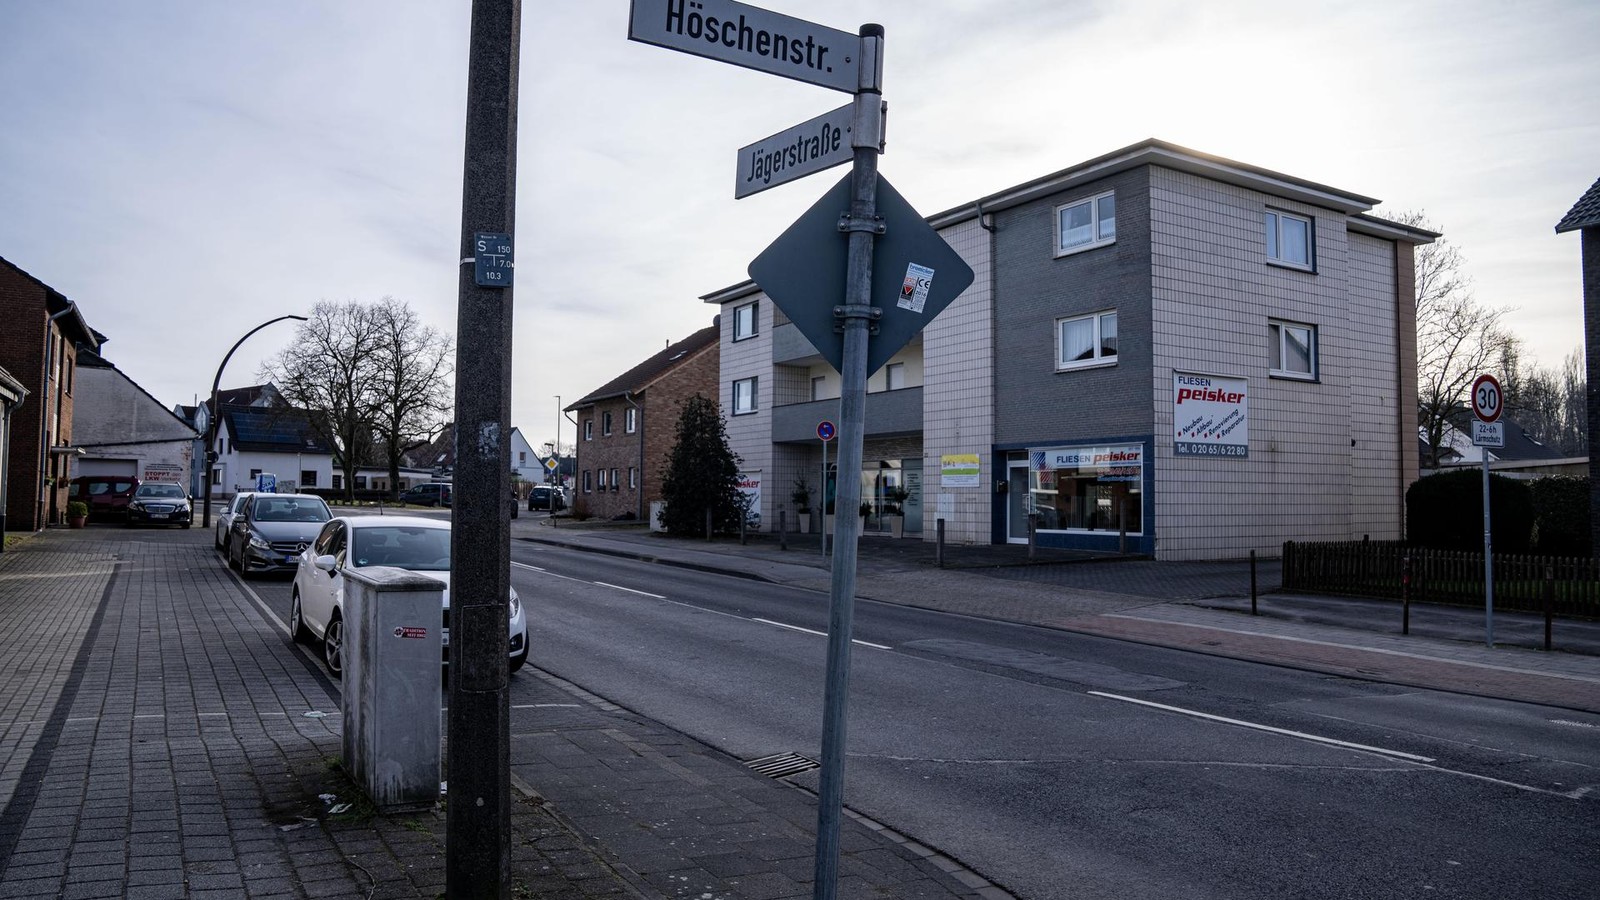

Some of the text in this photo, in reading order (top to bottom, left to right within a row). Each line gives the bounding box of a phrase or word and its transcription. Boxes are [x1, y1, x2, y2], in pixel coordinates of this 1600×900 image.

[666, 0, 833, 73] Höschenstr.
[747, 123, 841, 184] Jägerstraße
[478, 241, 511, 253] S 150
[486, 271, 502, 280] 10.3
[1178, 376, 1211, 387] FLIESEN
[1176, 387, 1246, 404] peisker
[1478, 388, 1496, 410] 30
[1181, 416, 1204, 435] Neubau
[1196, 419, 1213, 436] Altbau
[1208, 408, 1239, 437] Renovierung
[1221, 414, 1245, 437] Reparatur
[1177, 444, 1190, 453] Tel.
[1056, 455, 1091, 464] FLIESEN
[1093, 451, 1140, 465] peisker
